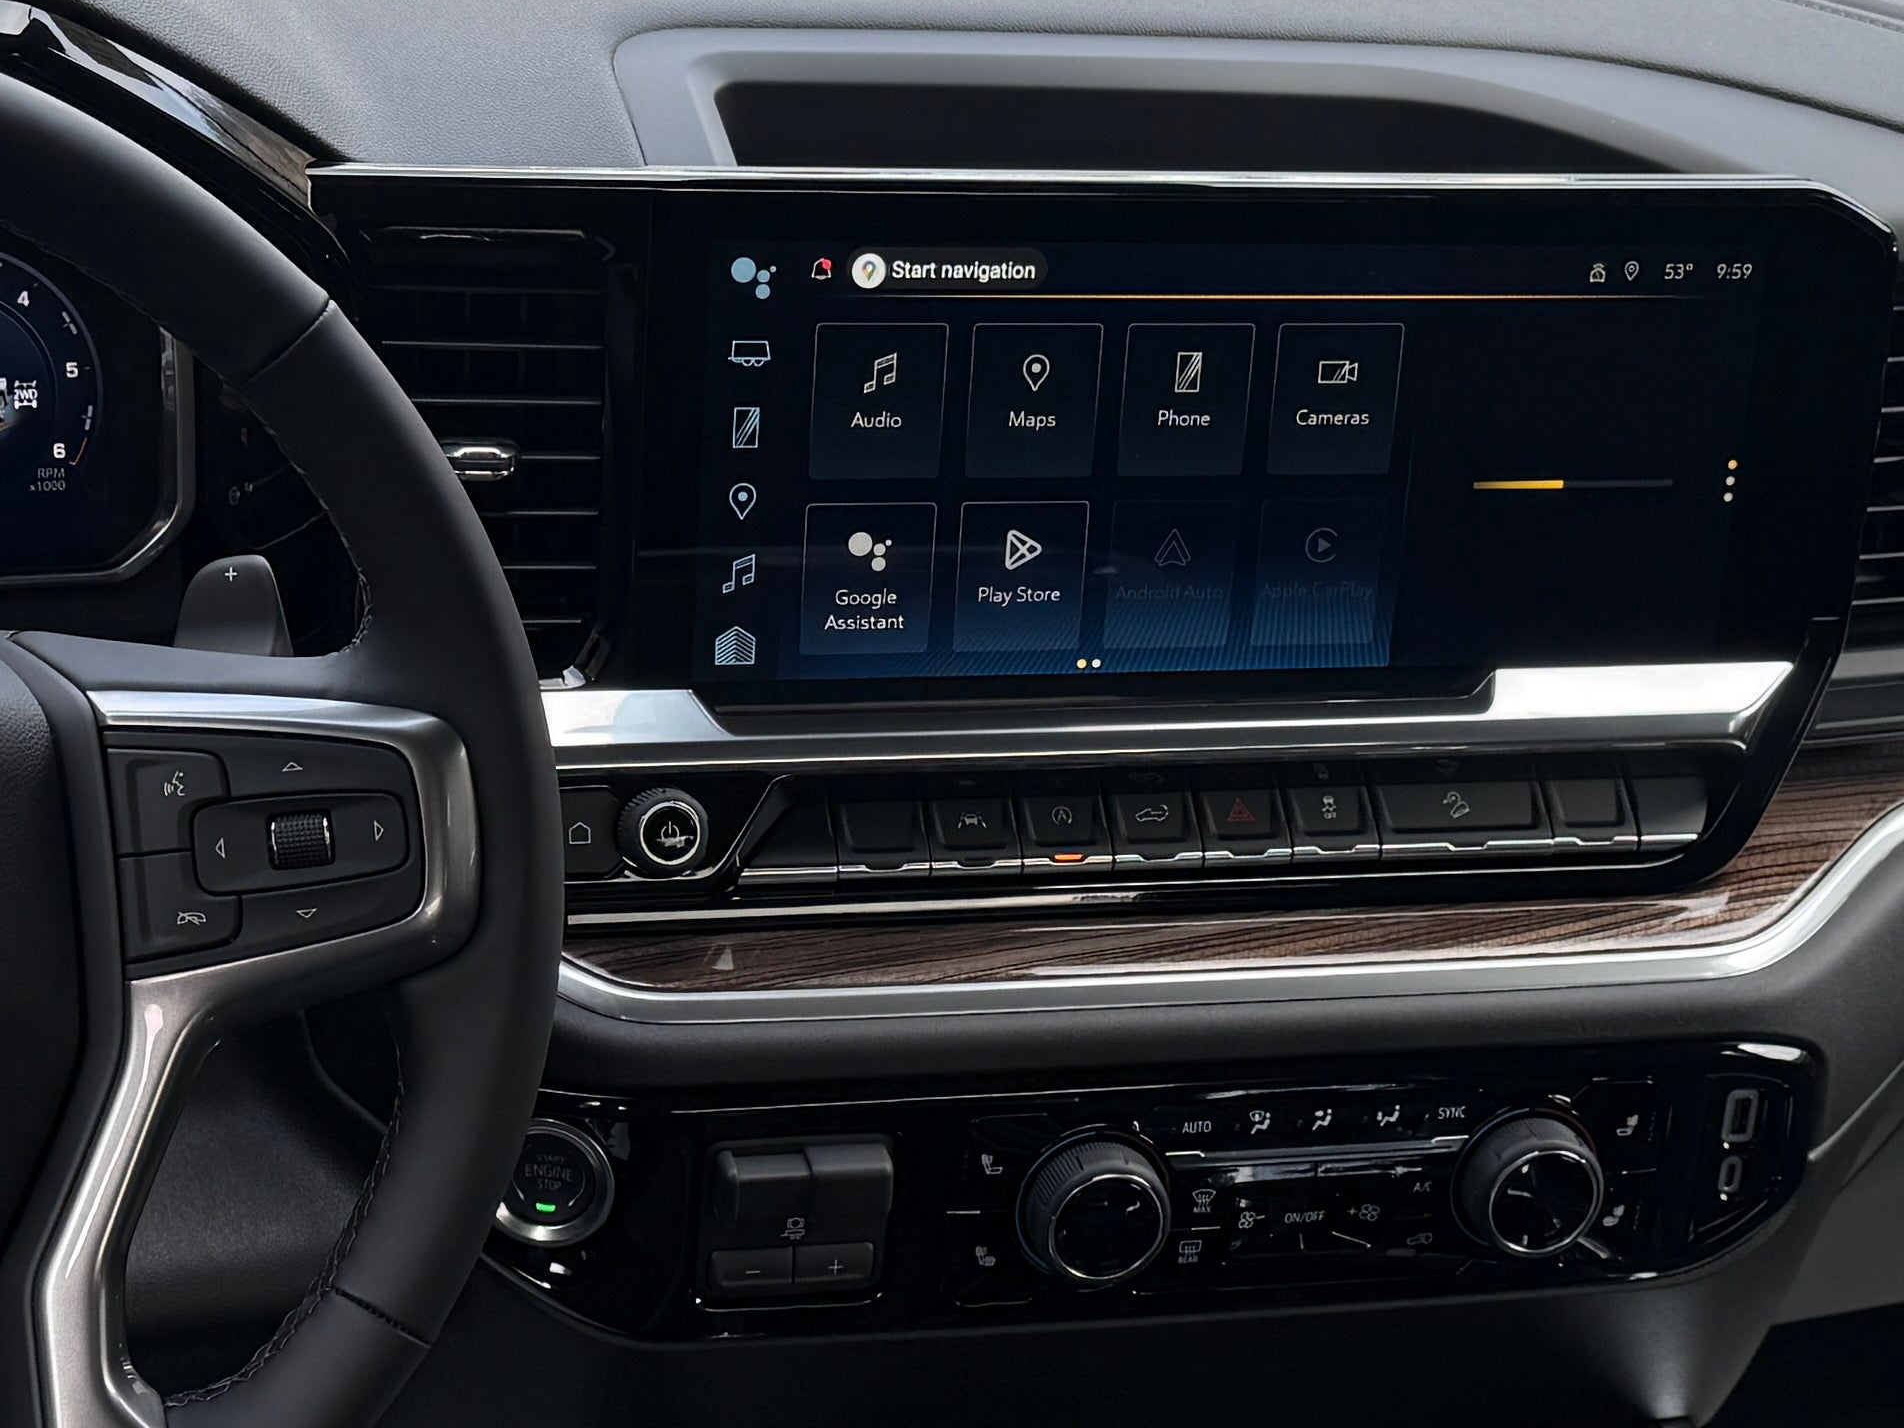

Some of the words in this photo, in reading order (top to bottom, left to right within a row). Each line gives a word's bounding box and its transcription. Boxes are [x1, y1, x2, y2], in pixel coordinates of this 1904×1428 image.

[891, 260, 937, 281] Start
[942, 260, 1036, 283] navigation
[1664, 264, 1694, 281] 53°
[1716, 263, 1753, 281] 9:59
[16, 290, 30, 307] 4
[66, 361, 79, 378] 5
[850, 411, 902, 429] Audio
[1008, 411, 1057, 433] Maps
[1157, 409, 1211, 428] Phone
[1296, 409, 1370, 427] Cameras
[52, 442, 67, 459] 6
[37, 467, 65, 479] RPM
[29, 479, 66, 492] x1000
[835, 588, 897, 608] Google
[977, 586, 1013, 606] Play
[1016, 586, 1061, 603] Store
[1115, 584, 1181, 600] Android
[1183, 585, 1224, 600] Auto
[1262, 583, 1306, 600] Apple
[1311, 580, 1375, 599] CarPlay
[824, 614, 904, 631] Assistant
[1437, 1106, 1466, 1120] SYNC
[1182, 1120, 1212, 1134] AUTO
[525, 1163, 573, 1182] ENGINE
[1284, 1210, 1325, 1224] ON/OFF
